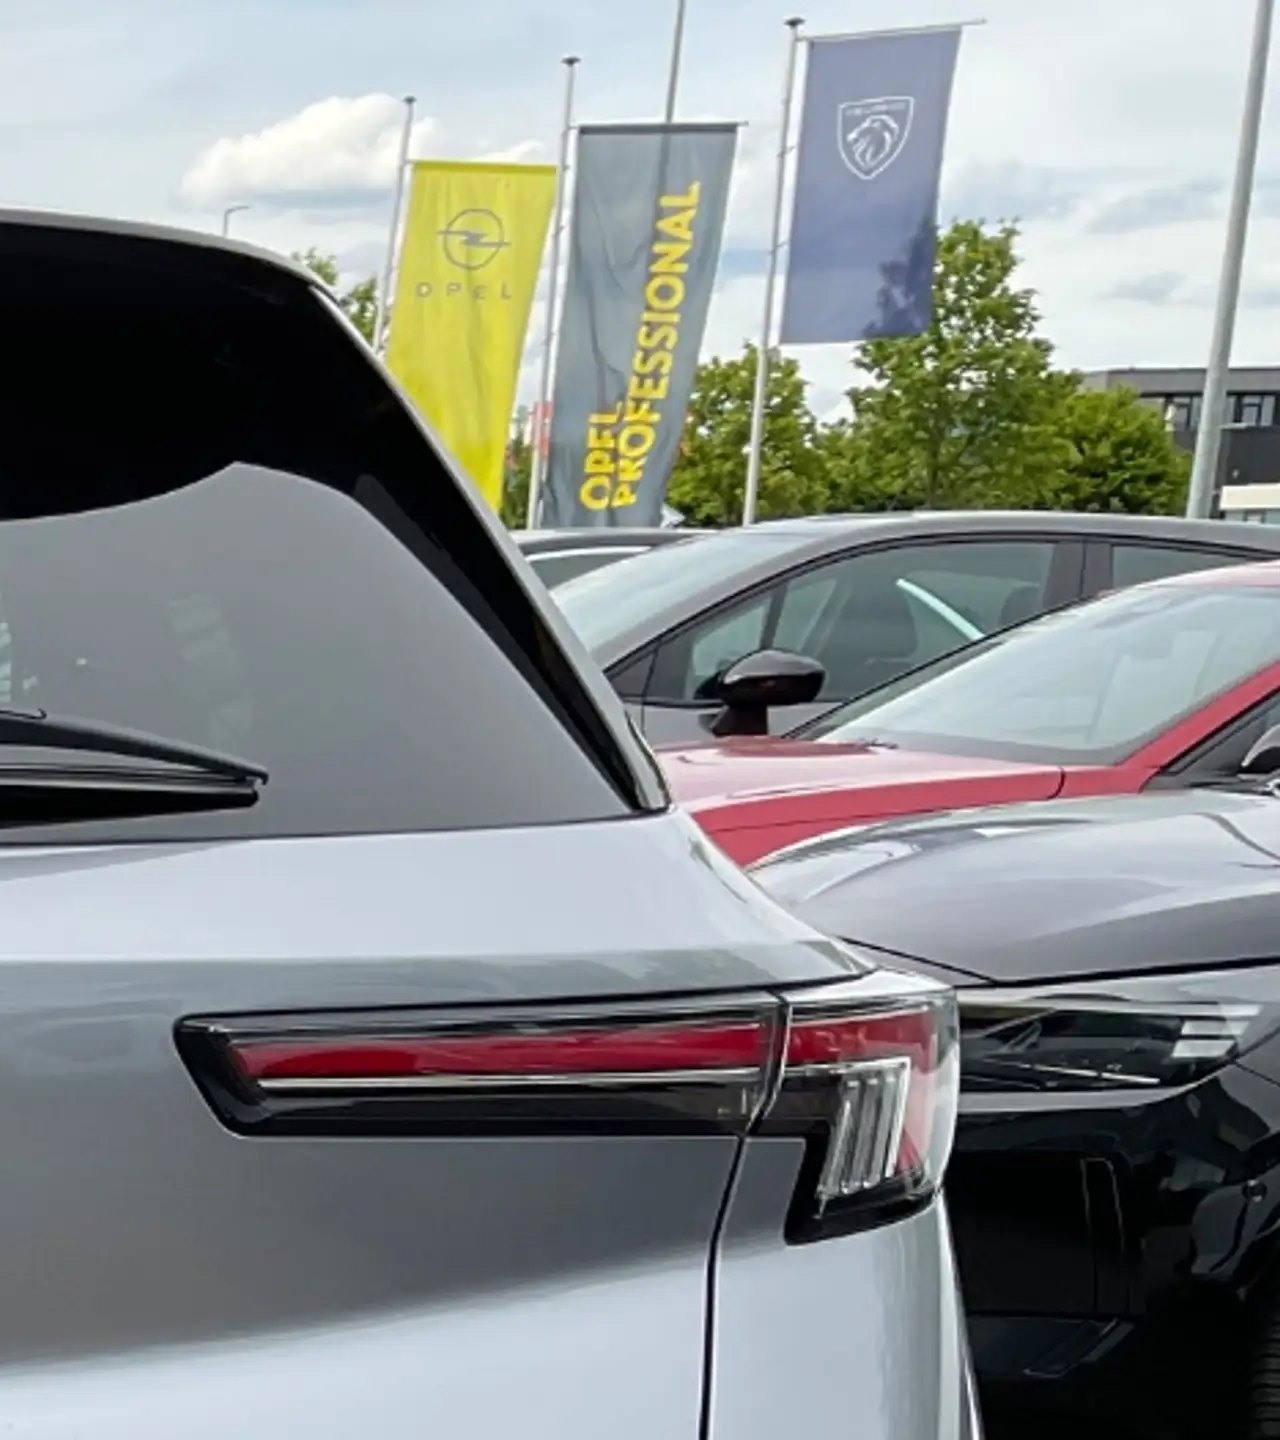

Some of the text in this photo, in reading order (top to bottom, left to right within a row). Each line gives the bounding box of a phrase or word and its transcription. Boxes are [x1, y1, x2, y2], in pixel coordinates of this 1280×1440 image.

[415, 281, 513, 300] OPEL
[611, 180, 701, 509] PROFESSIONAL
[579, 401, 623, 510] OPEL
